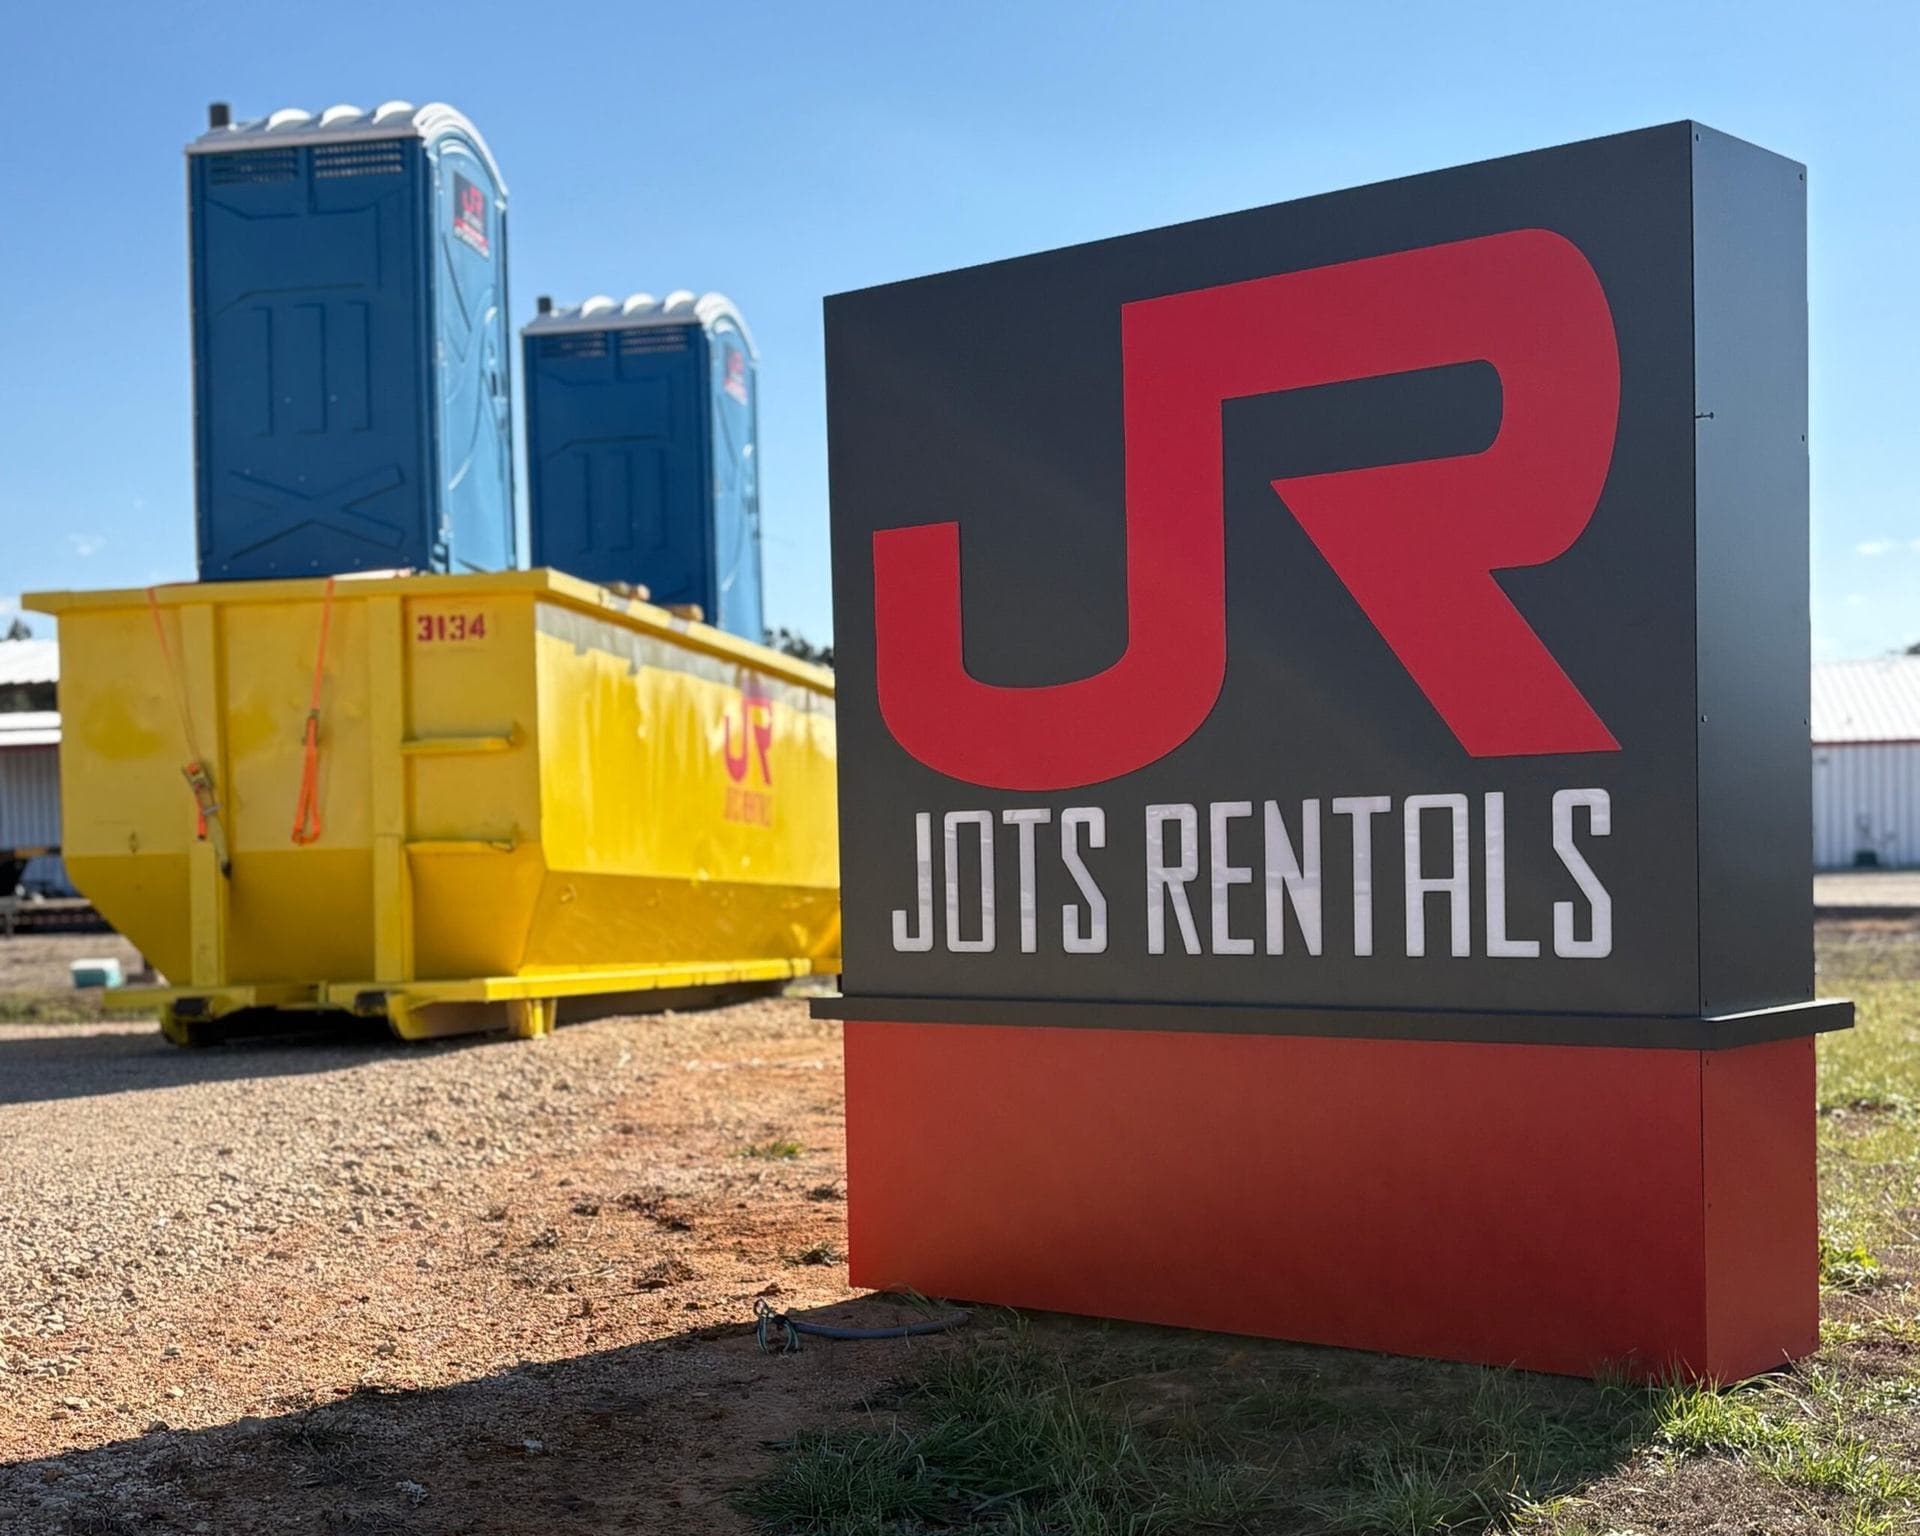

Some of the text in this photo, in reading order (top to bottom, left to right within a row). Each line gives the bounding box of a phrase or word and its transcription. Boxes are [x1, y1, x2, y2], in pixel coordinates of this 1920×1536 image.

[873, 228, 1621, 790] JR
[417, 613, 485, 641] 3134
[723, 677, 772, 784] JR
[892, 788, 1612, 958] JOTS RENTALS
